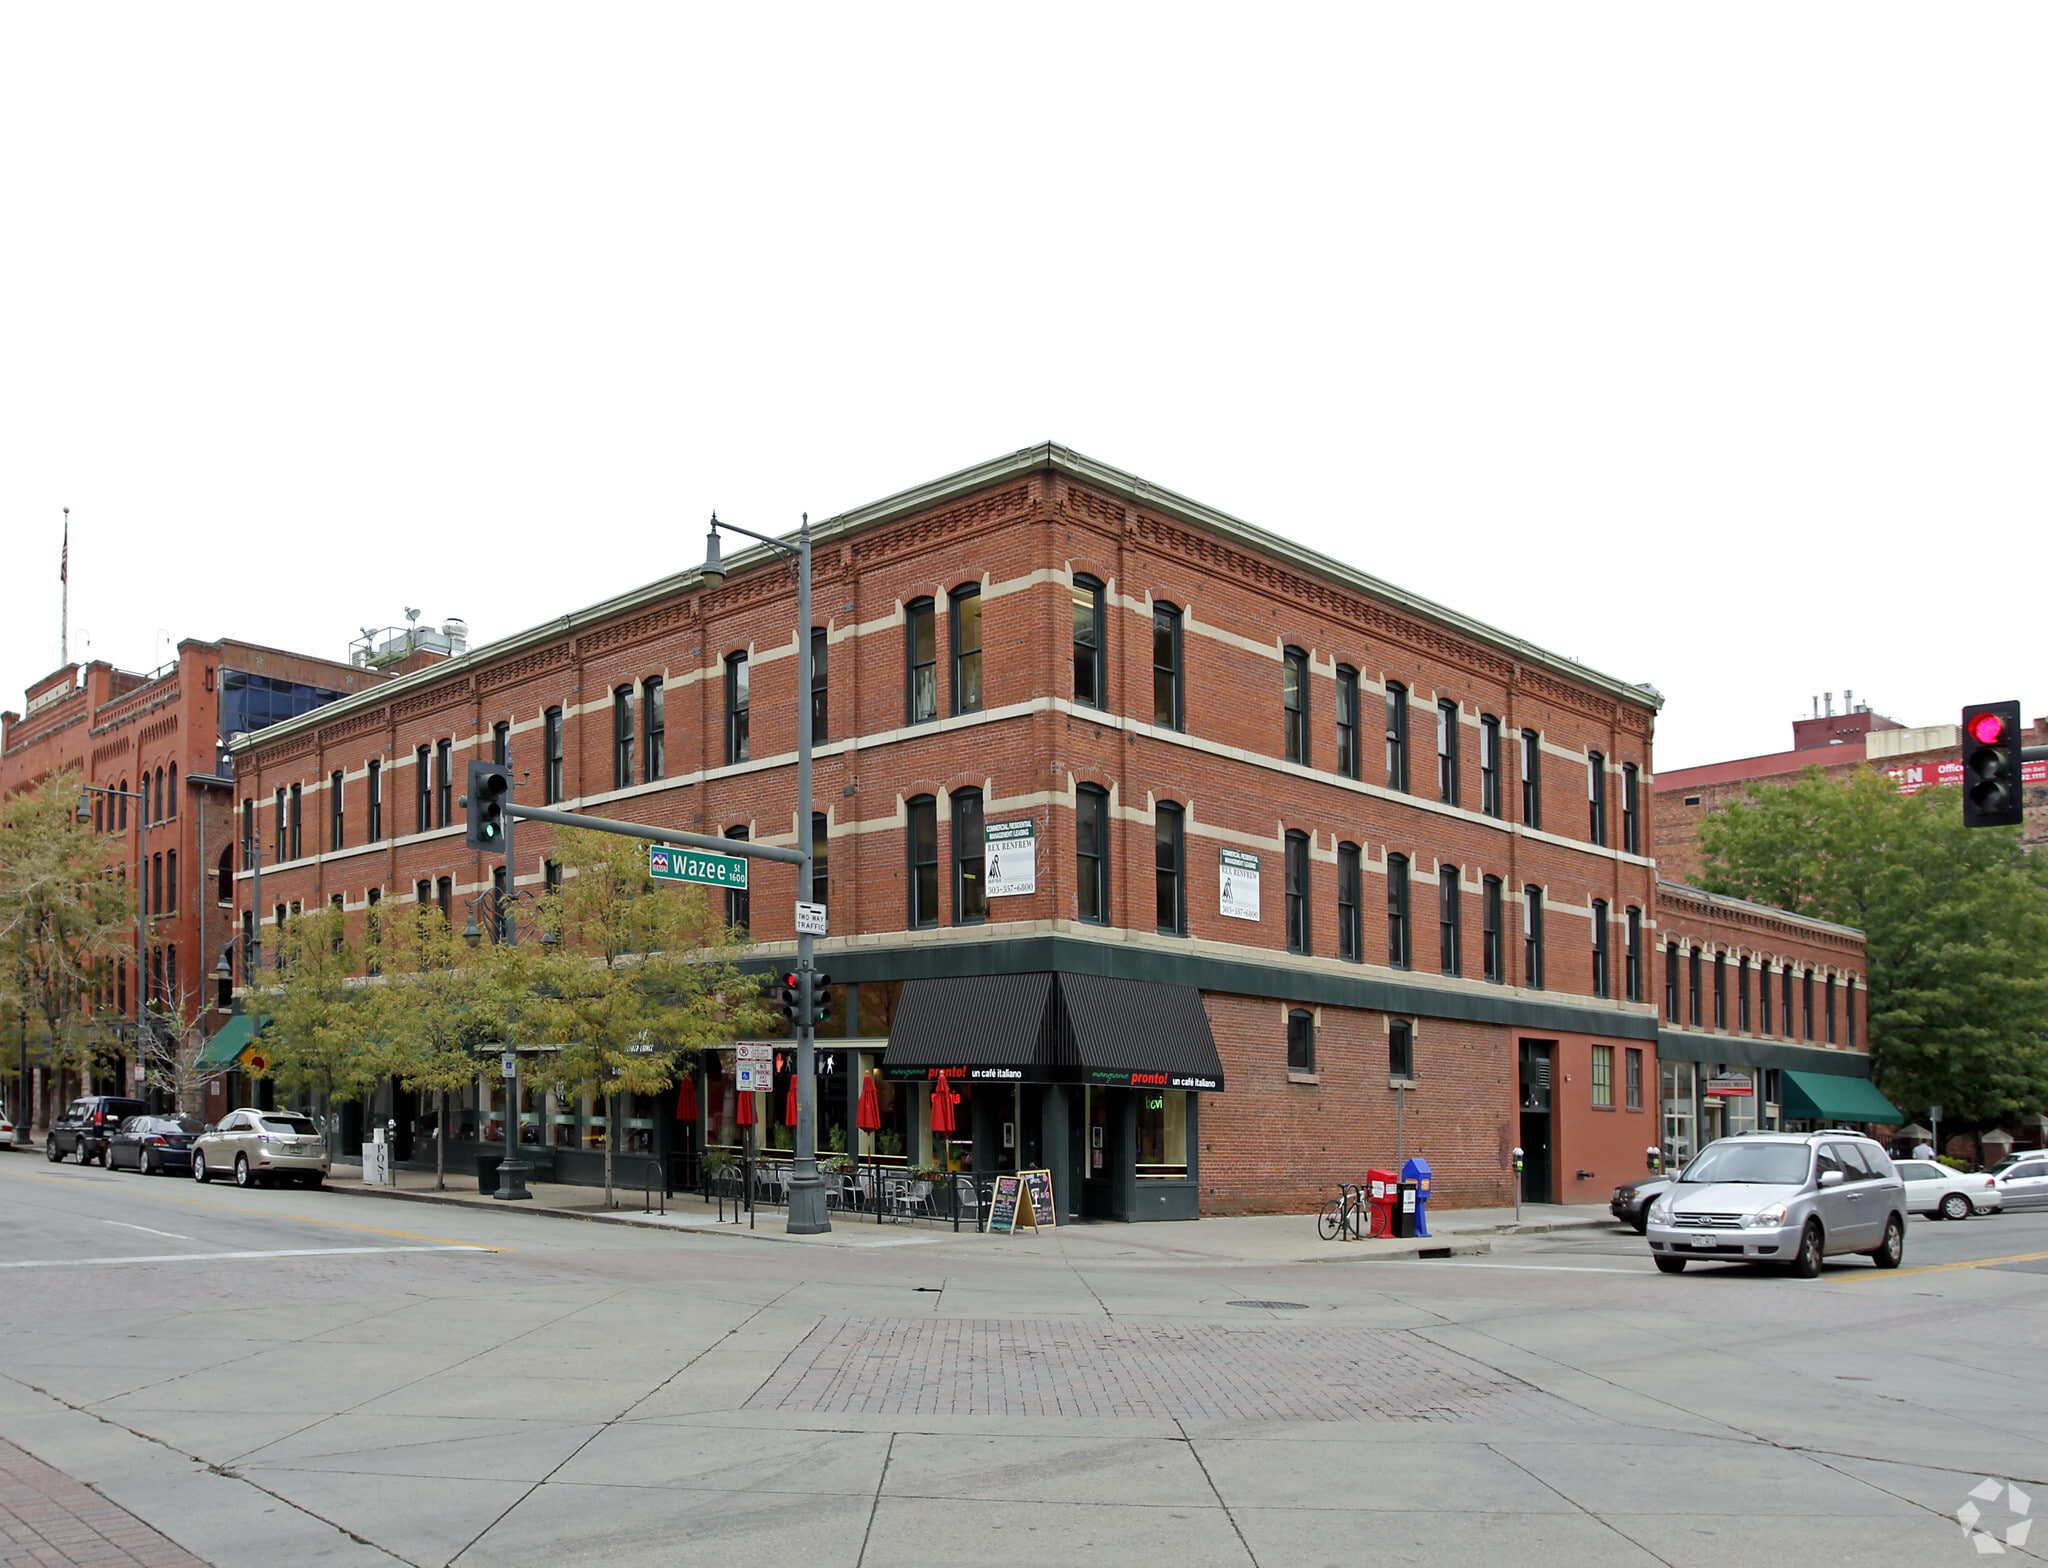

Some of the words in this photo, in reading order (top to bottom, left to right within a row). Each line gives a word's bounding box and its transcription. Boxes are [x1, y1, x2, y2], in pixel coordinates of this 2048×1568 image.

[1002, 840, 1032, 850] RENFREW
[672, 854, 726, 881] Wazee
[733, 864, 741, 873] St
[729, 873, 745, 883] 1600
[798, 913, 810, 921] TWO
[812, 915, 825, 923] WAY
[797, 921, 825, 931] TRAFFIC
[928, 1065, 967, 1080] prnto!
[971, 1069, 980, 1078] un
[981, 1068, 996, 1078] café
[997, 1068, 1022, 1079] italiano
[1131, 1072, 1168, 1085] pronto!
[1172, 1078, 1181, 1086] un
[1181, 1078, 1194, 1087] café
[1194, 1078, 1216, 1088] italiano
[376, 1144, 385, 1182] POST
